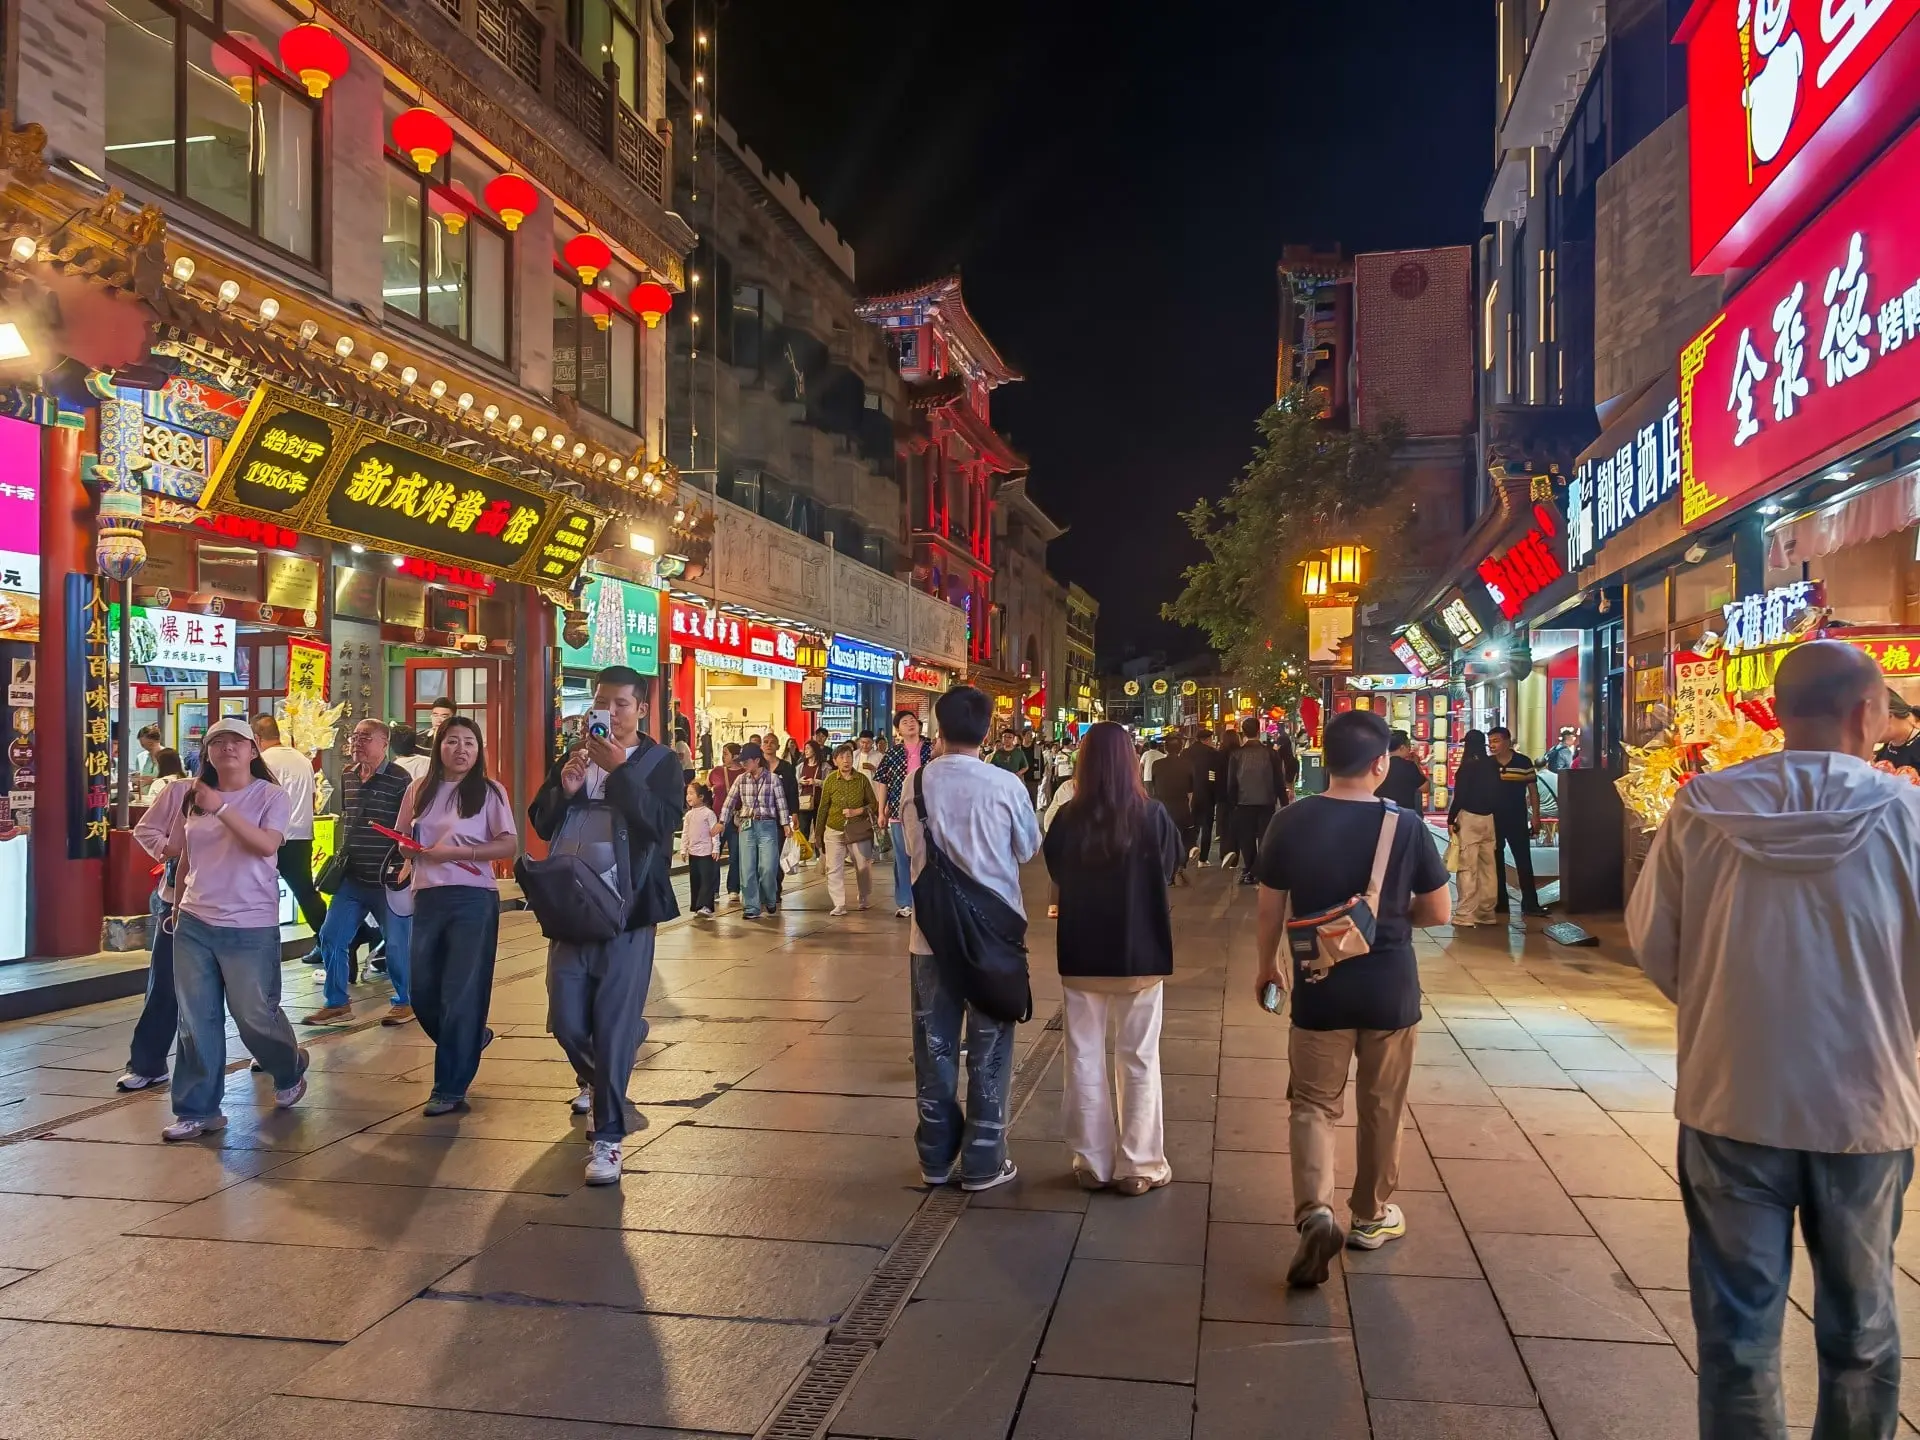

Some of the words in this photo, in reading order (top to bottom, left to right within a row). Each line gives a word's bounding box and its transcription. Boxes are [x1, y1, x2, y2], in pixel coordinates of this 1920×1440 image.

[261, 427, 325, 463] 始创于
[1597, 397, 1681, 540] 潮漫酒店
[243, 460, 309, 494] 1956年
[344, 457, 540, 546] 新成炸酱面馆
[160, 615, 228, 648] 爆肚王
[626, 609, 657, 637] 羊肉串
[1723, 581, 1809, 652] 冰糖葫芦
[84, 577, 109, 843] 人生百味喜悦面对
